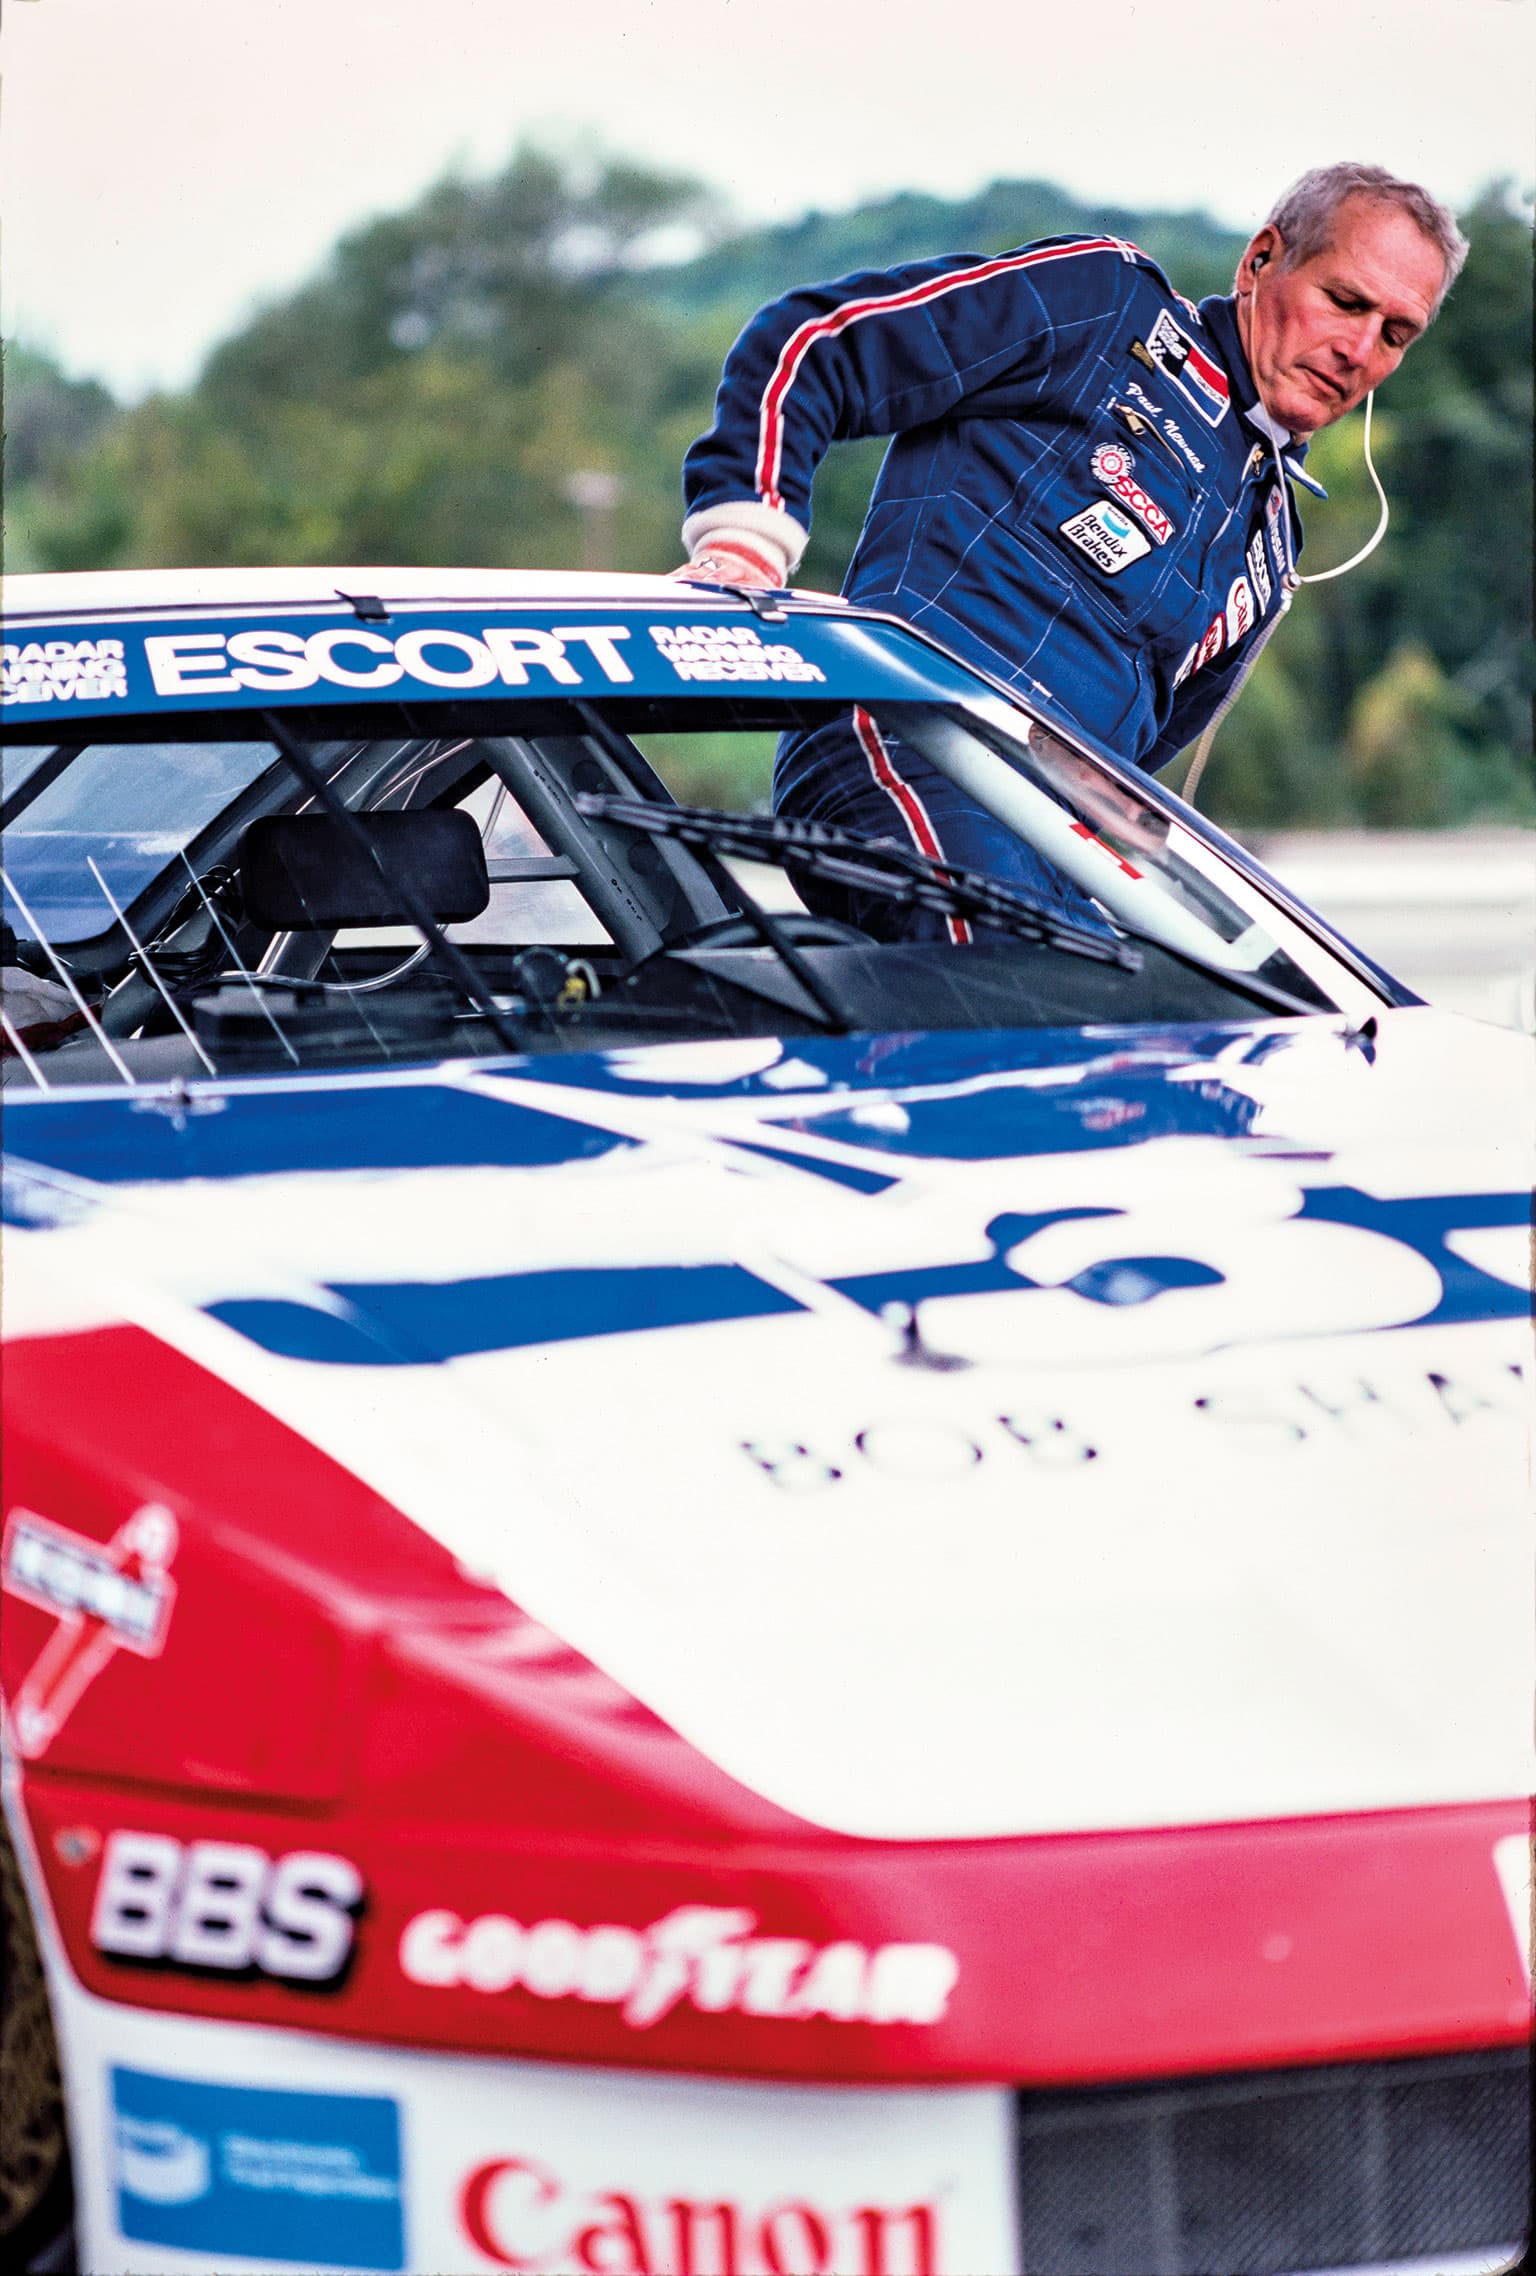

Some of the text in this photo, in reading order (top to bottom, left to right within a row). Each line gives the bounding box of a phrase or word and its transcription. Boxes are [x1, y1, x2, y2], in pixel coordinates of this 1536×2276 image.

[1125, 382, 1206, 473] Paul Newman
[1081, 514, 1128, 558] Bendix
[1114, 475, 1169, 542] SCCA
[1067, 523, 1116, 568] Brakes
[144, 626, 635, 697] ESCORT
[648, 626, 762, 645] RADAR
[656, 645, 804, 663] WARNING
[673, 661, 828, 682] RECEIVER
[91, 1829, 364, 1982] BBS
[400, 1905, 960, 2028] GOODYEAR
[458, 2156, 938, 2276] Canon
